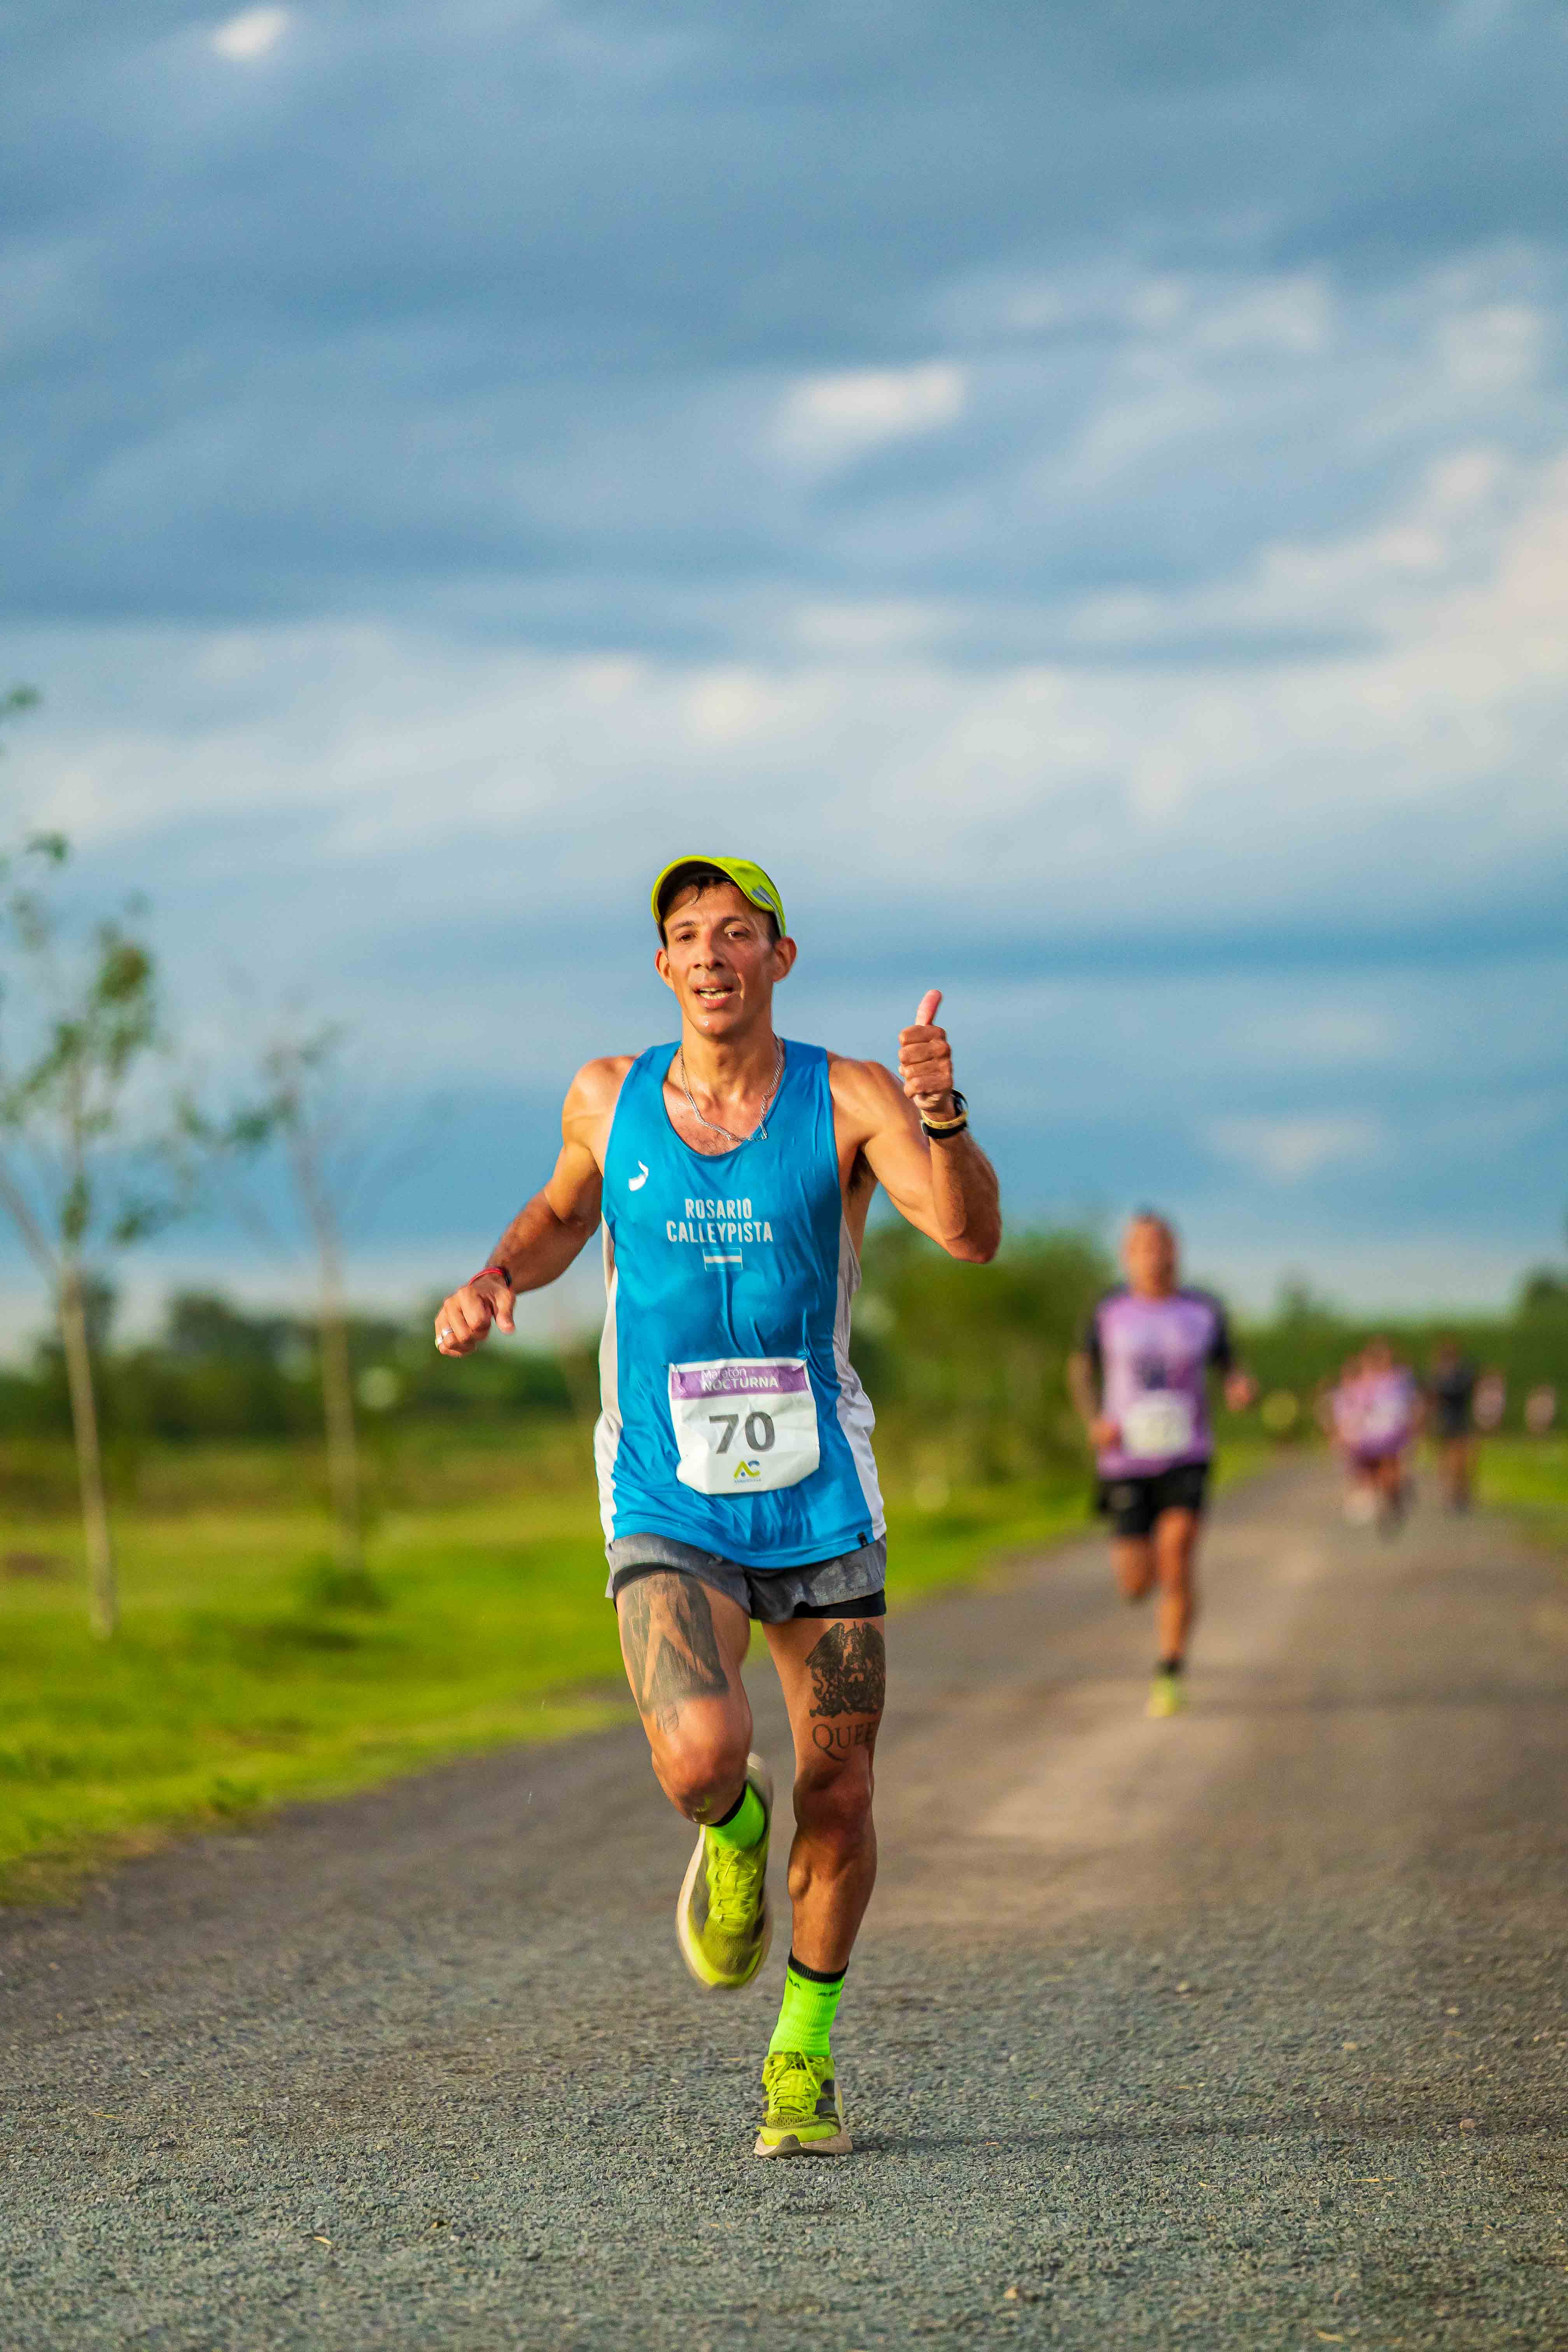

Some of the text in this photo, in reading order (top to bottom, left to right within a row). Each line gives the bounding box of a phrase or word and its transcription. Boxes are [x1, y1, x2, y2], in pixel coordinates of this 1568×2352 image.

[685, 1198, 752, 1219] ROSARIO
[666, 1220, 773, 1243] CALLEYPISTA
[702, 1376, 779, 1391] NOCTURNA
[709, 1411, 775, 1454] 70
[812, 1721, 877, 1761] QUEE
